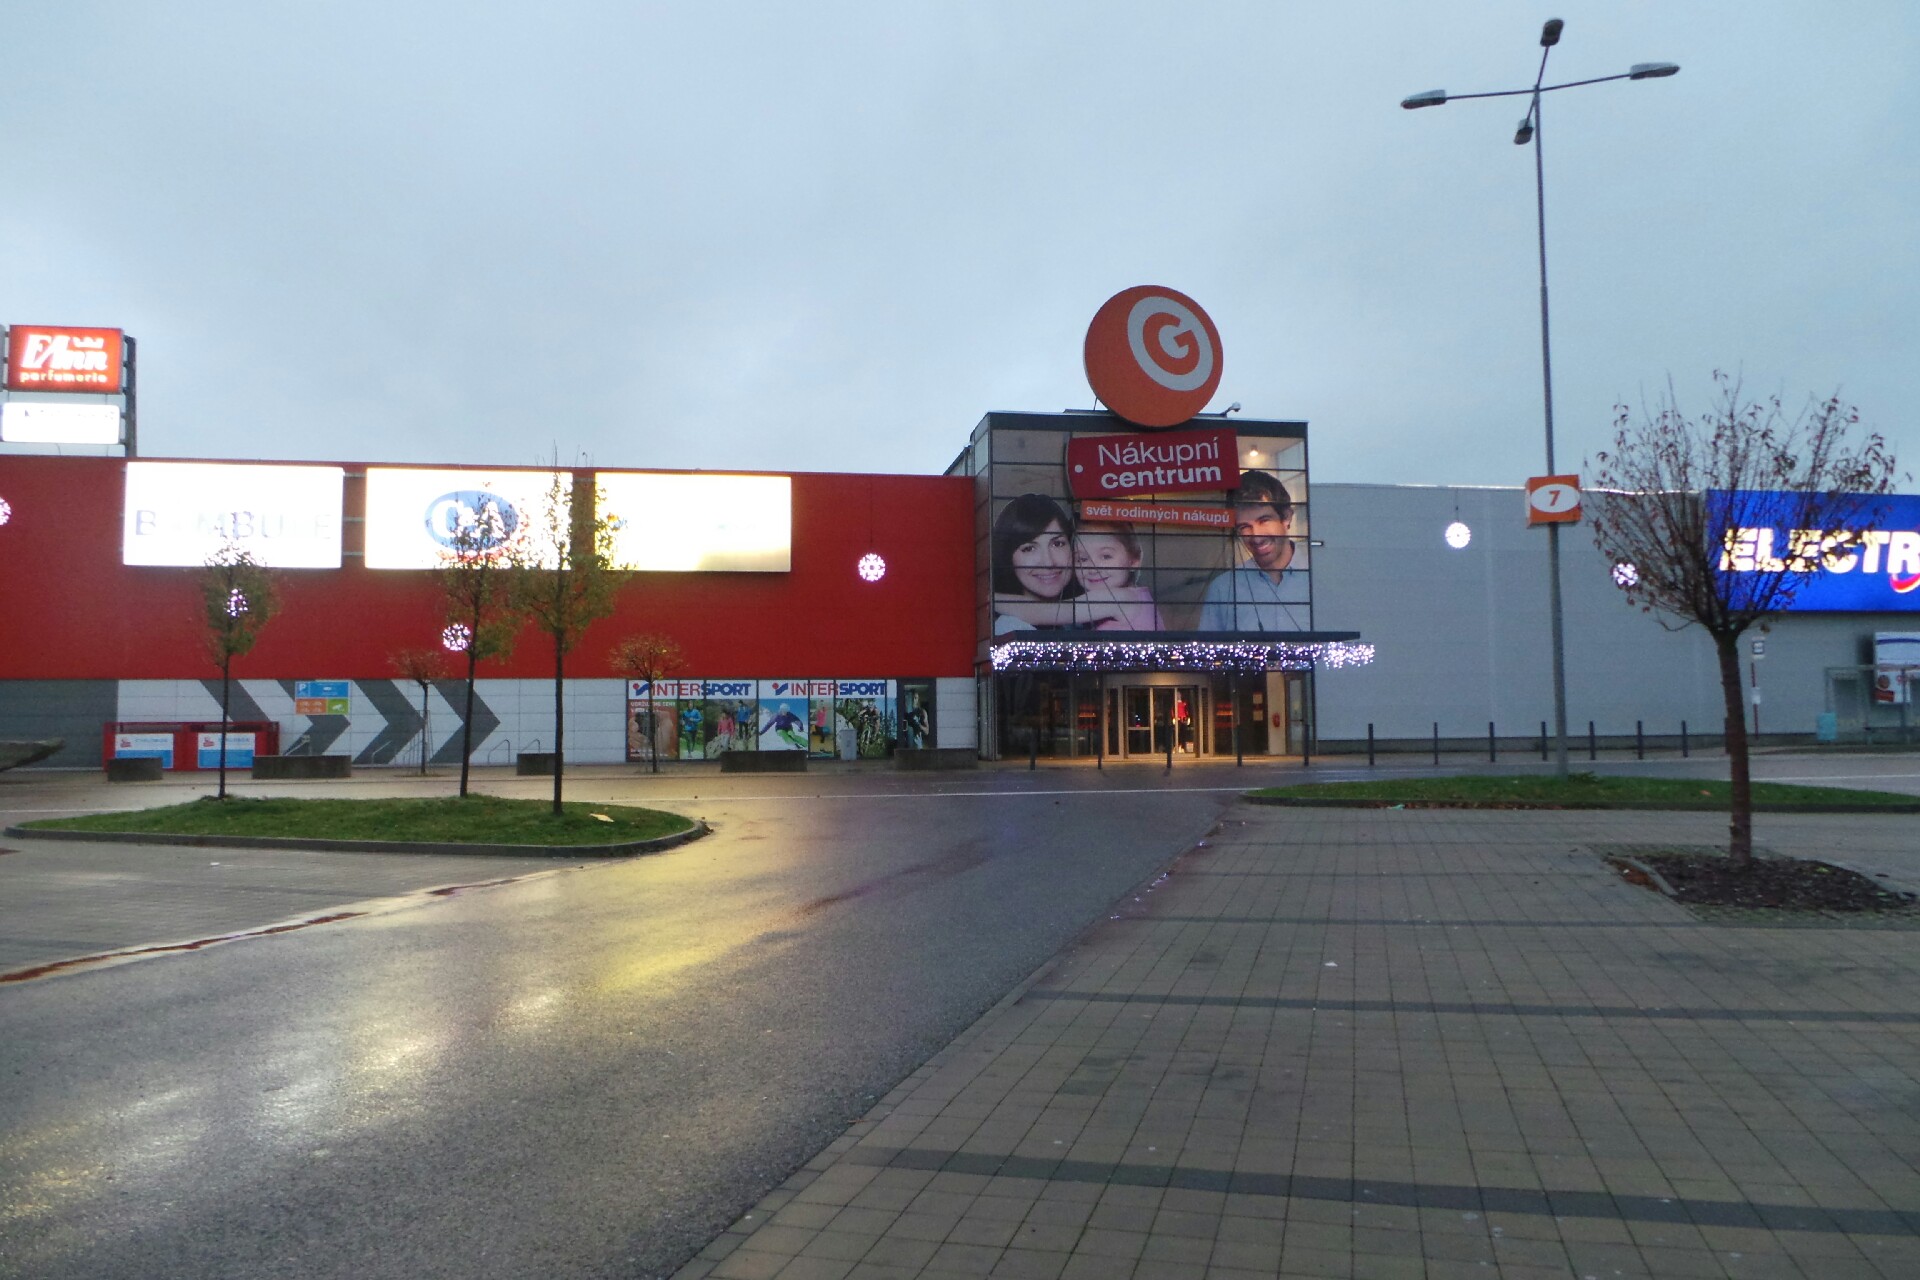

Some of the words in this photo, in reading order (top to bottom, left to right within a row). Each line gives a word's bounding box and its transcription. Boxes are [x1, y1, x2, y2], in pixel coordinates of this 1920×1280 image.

[1098, 436, 1219, 467] Nákupní
[1101, 464, 1222, 490] centrum
[1548, 489, 1561, 507] 7
[135, 508, 332, 540] BMBUE
[1086, 504, 1112, 517] svět
[1116, 506, 1179, 521] rodinných
[1183, 508, 1230, 524] nákupů
[651, 682, 752, 697] INTERSPORT
[790, 682, 887, 697] INTERSPORT
